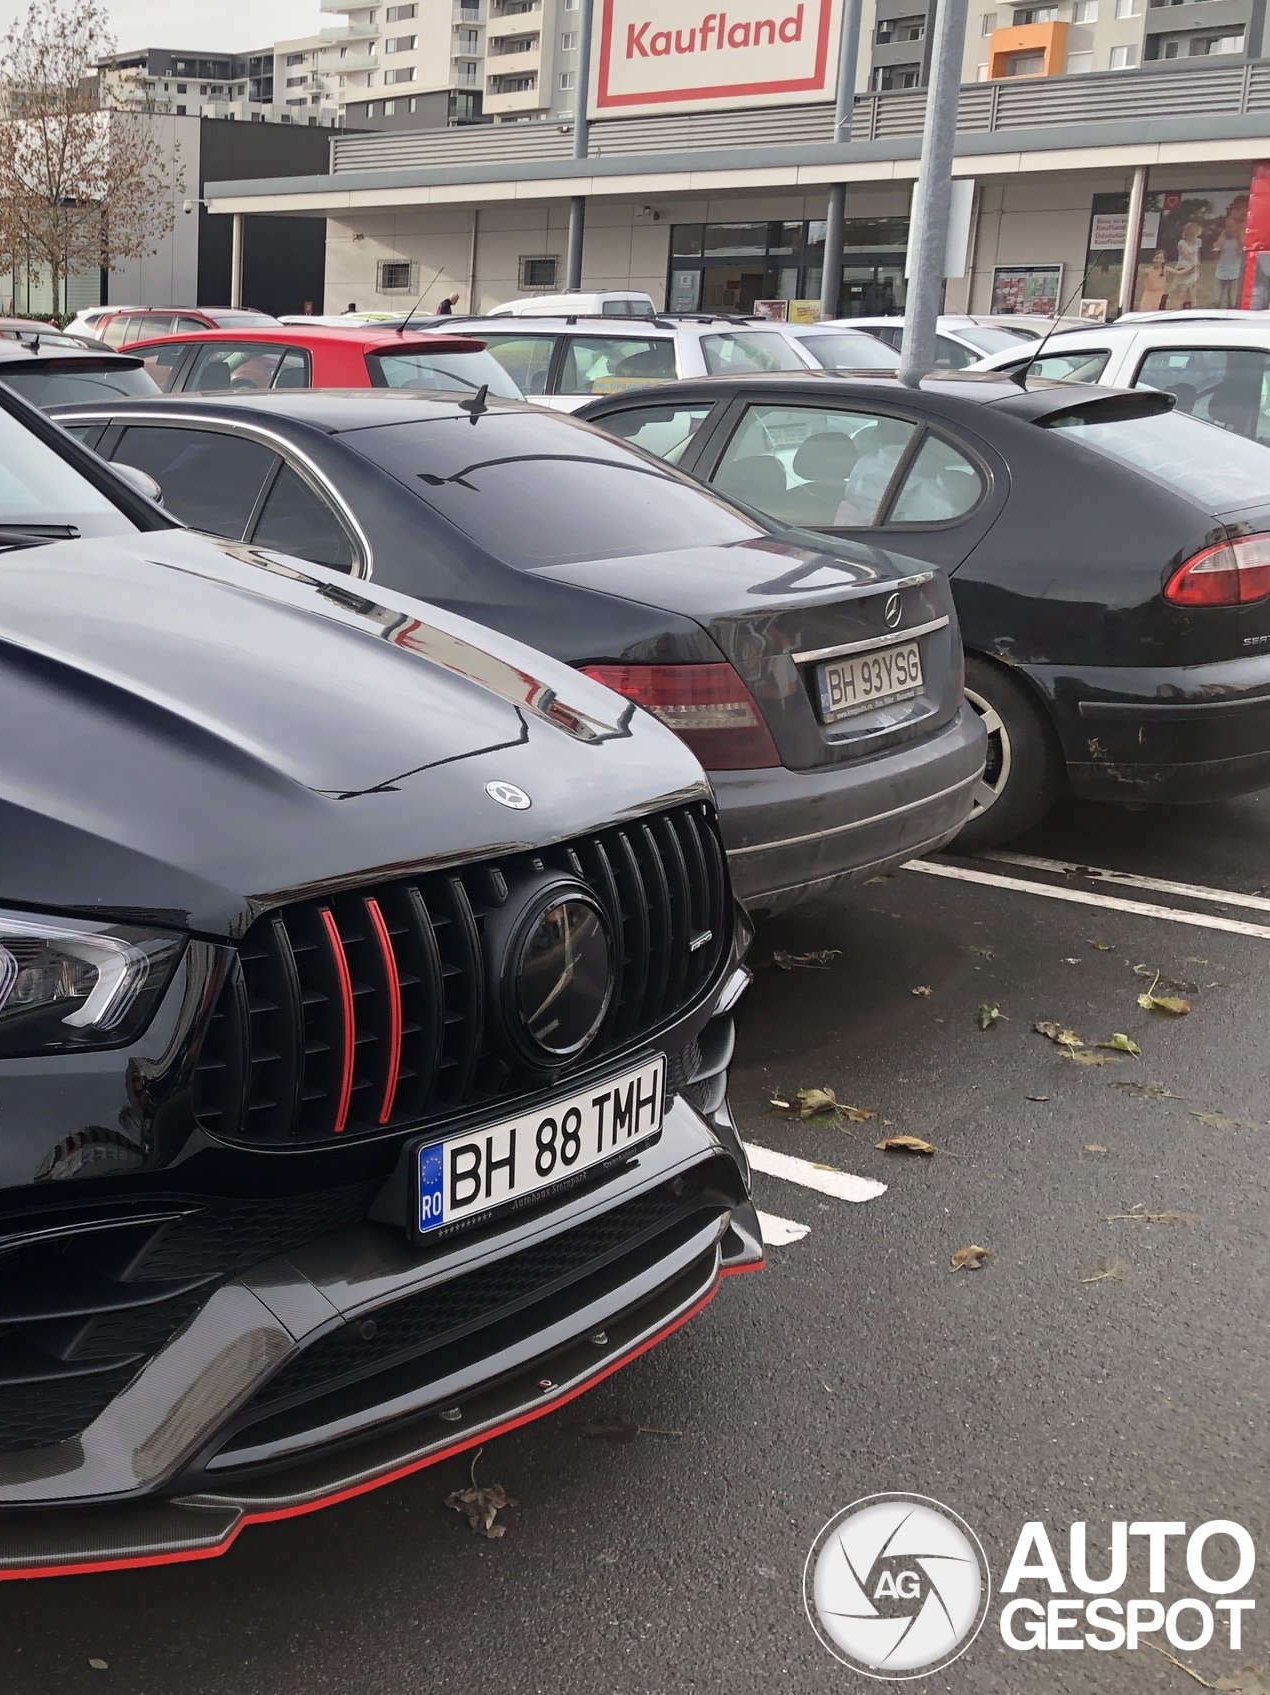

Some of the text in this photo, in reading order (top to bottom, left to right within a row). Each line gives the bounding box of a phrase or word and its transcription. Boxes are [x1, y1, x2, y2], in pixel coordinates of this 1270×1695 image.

[626, 3, 804, 59] Kaufland
[829, 664, 857, 706] BH
[450, 1069, 658, 1211] BH 88 TMH
[422, 1191, 442, 1221] RO
[512, 1187, 550, 1210] Autohaus
